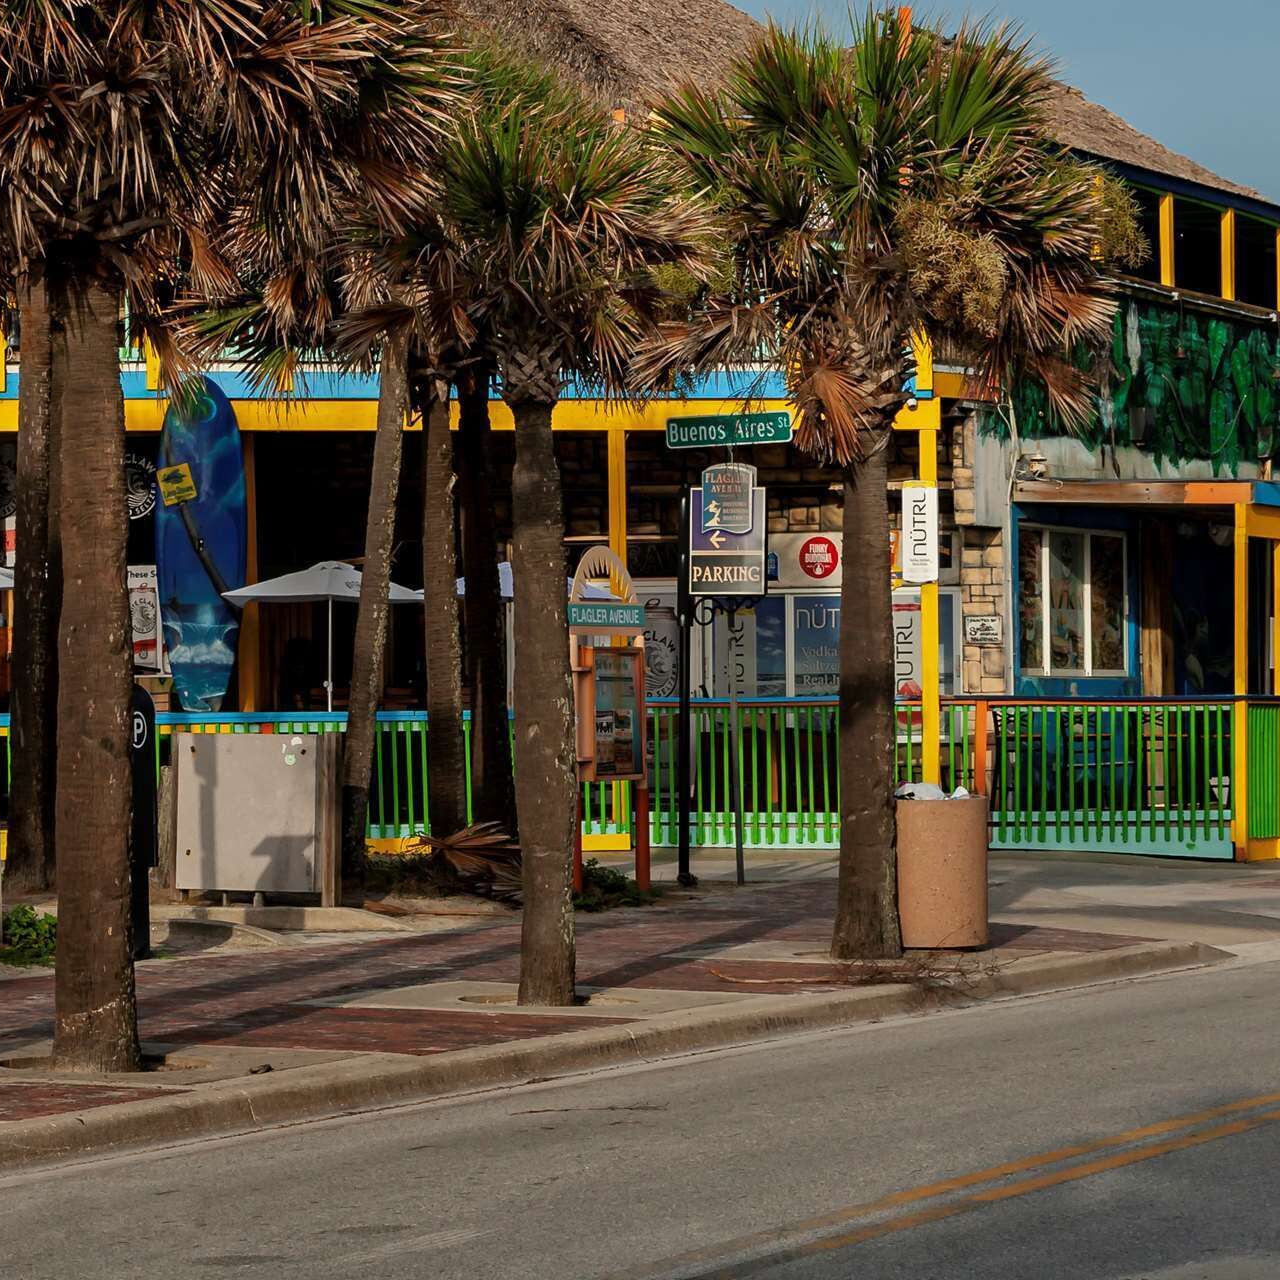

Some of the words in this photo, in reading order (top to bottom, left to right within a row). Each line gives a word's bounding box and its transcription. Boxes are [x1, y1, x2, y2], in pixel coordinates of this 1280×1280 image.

[669, 422, 727, 443] Buenos
[735, 417, 776, 439] Aires
[808, 543, 828, 553] FUNKY
[692, 566, 761, 583] PARKING
[571, 607, 608, 624] FLAGLER
[609, 609, 640, 624] AVENUE
[795, 603, 841, 629] NÜT
[643, 630, 677, 655] CLAW
[803, 674, 828, 687] Real
[133, 718, 144, 742] P
